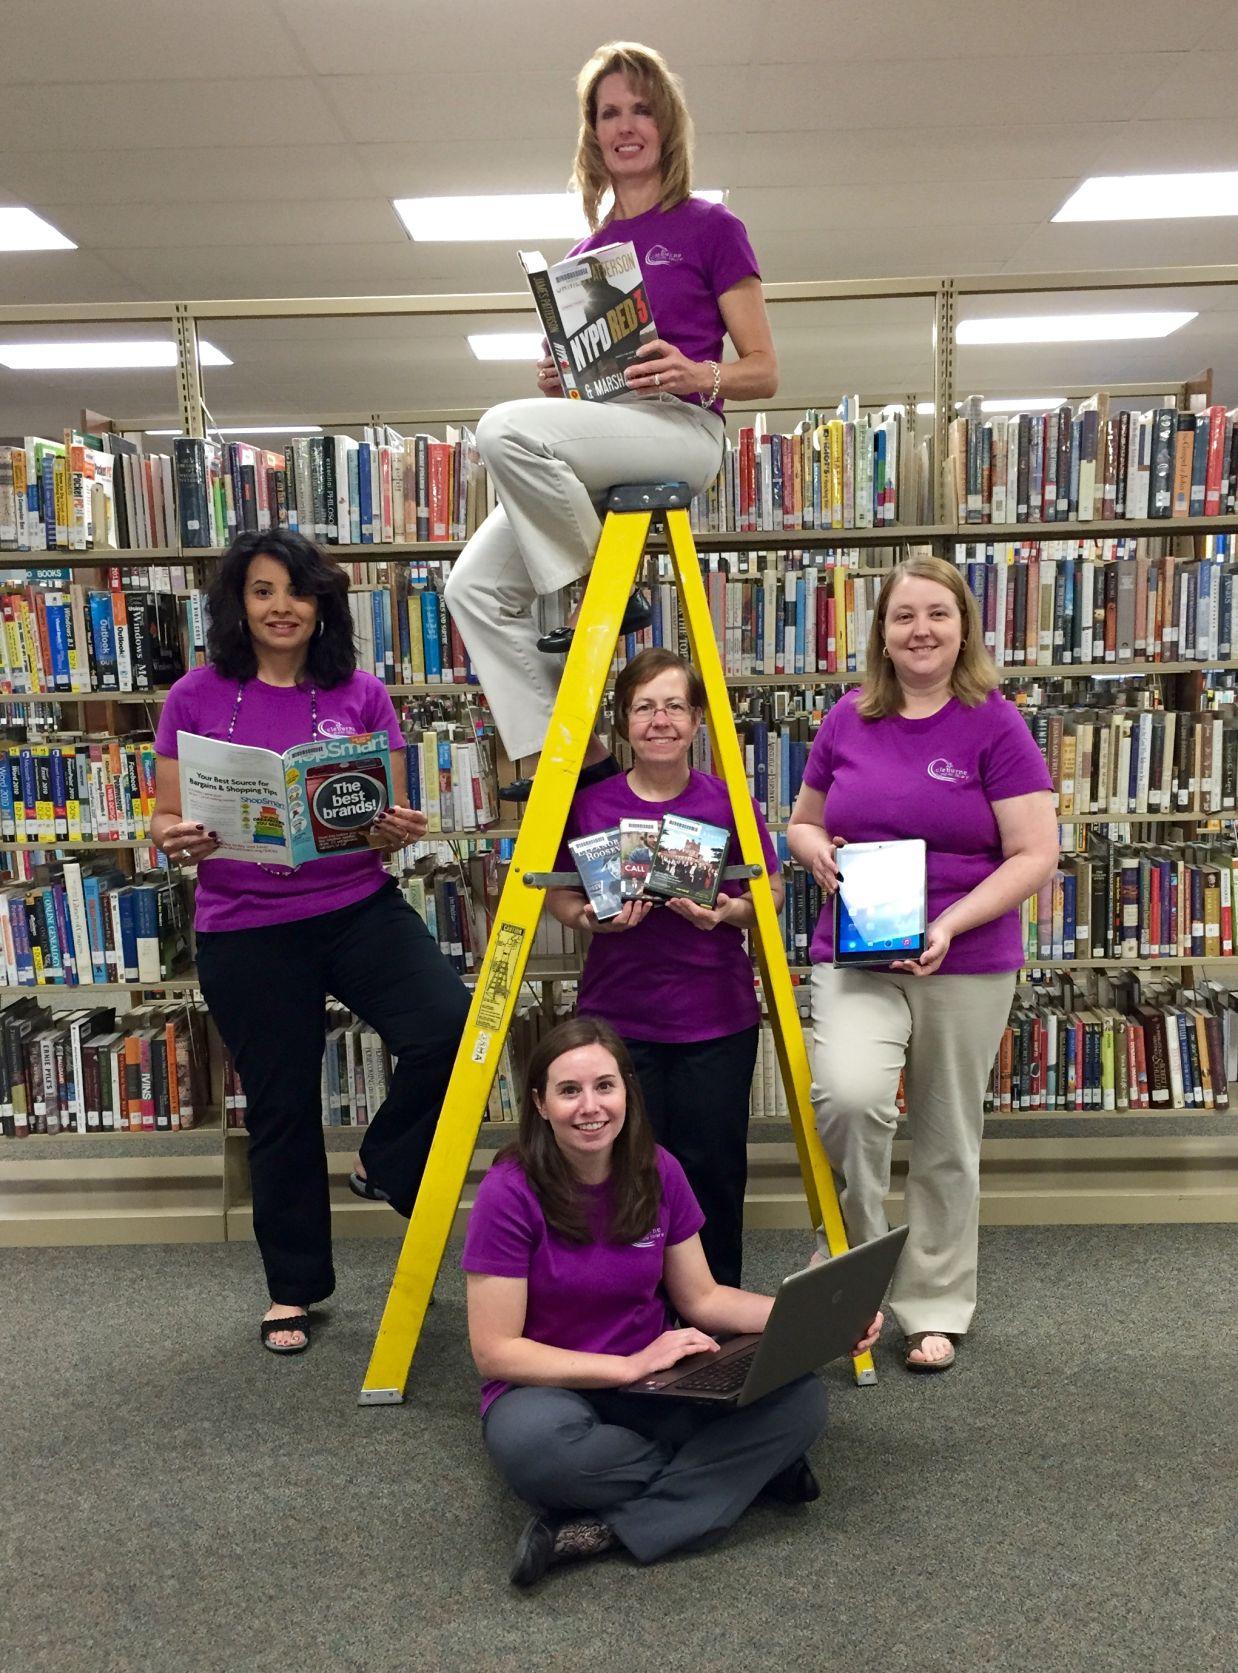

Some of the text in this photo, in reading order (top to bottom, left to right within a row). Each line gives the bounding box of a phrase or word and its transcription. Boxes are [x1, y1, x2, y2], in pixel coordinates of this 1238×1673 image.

[570, 288, 648, 373] NYPD RED 3
[584, 372, 626, 400] & MARSH
[73, 473, 83, 498] Pocket
[37, 569, 62, 578] BOOKS
[64, 607, 72, 637] Windows
[100, 619, 110, 654] Outlook
[117, 626, 125, 656] Outlook
[132, 612, 144, 659] Windows
[680, 639, 688, 657] TOP
[1039, 719, 1048, 744] MIND
[0, 766, 8, 787] Word
[129, 761, 137, 792] Facebook
[189, 778, 217, 790] Bargains
[226, 785, 262, 795] Shopping
[263, 788, 278, 796] Tips
[196, 772, 212, 782] Your
[214, 776, 229, 785] Best
[231, 779, 256, 787] Source
[333, 781, 361, 795] The
[323, 799, 376, 819] brands!
[332, 790, 365, 806] best
[624, 864, 645, 873] CALL
[45, 900, 60, 967] ONLINE GENEALOGY
[141, 1072, 151, 1100] IVINS
